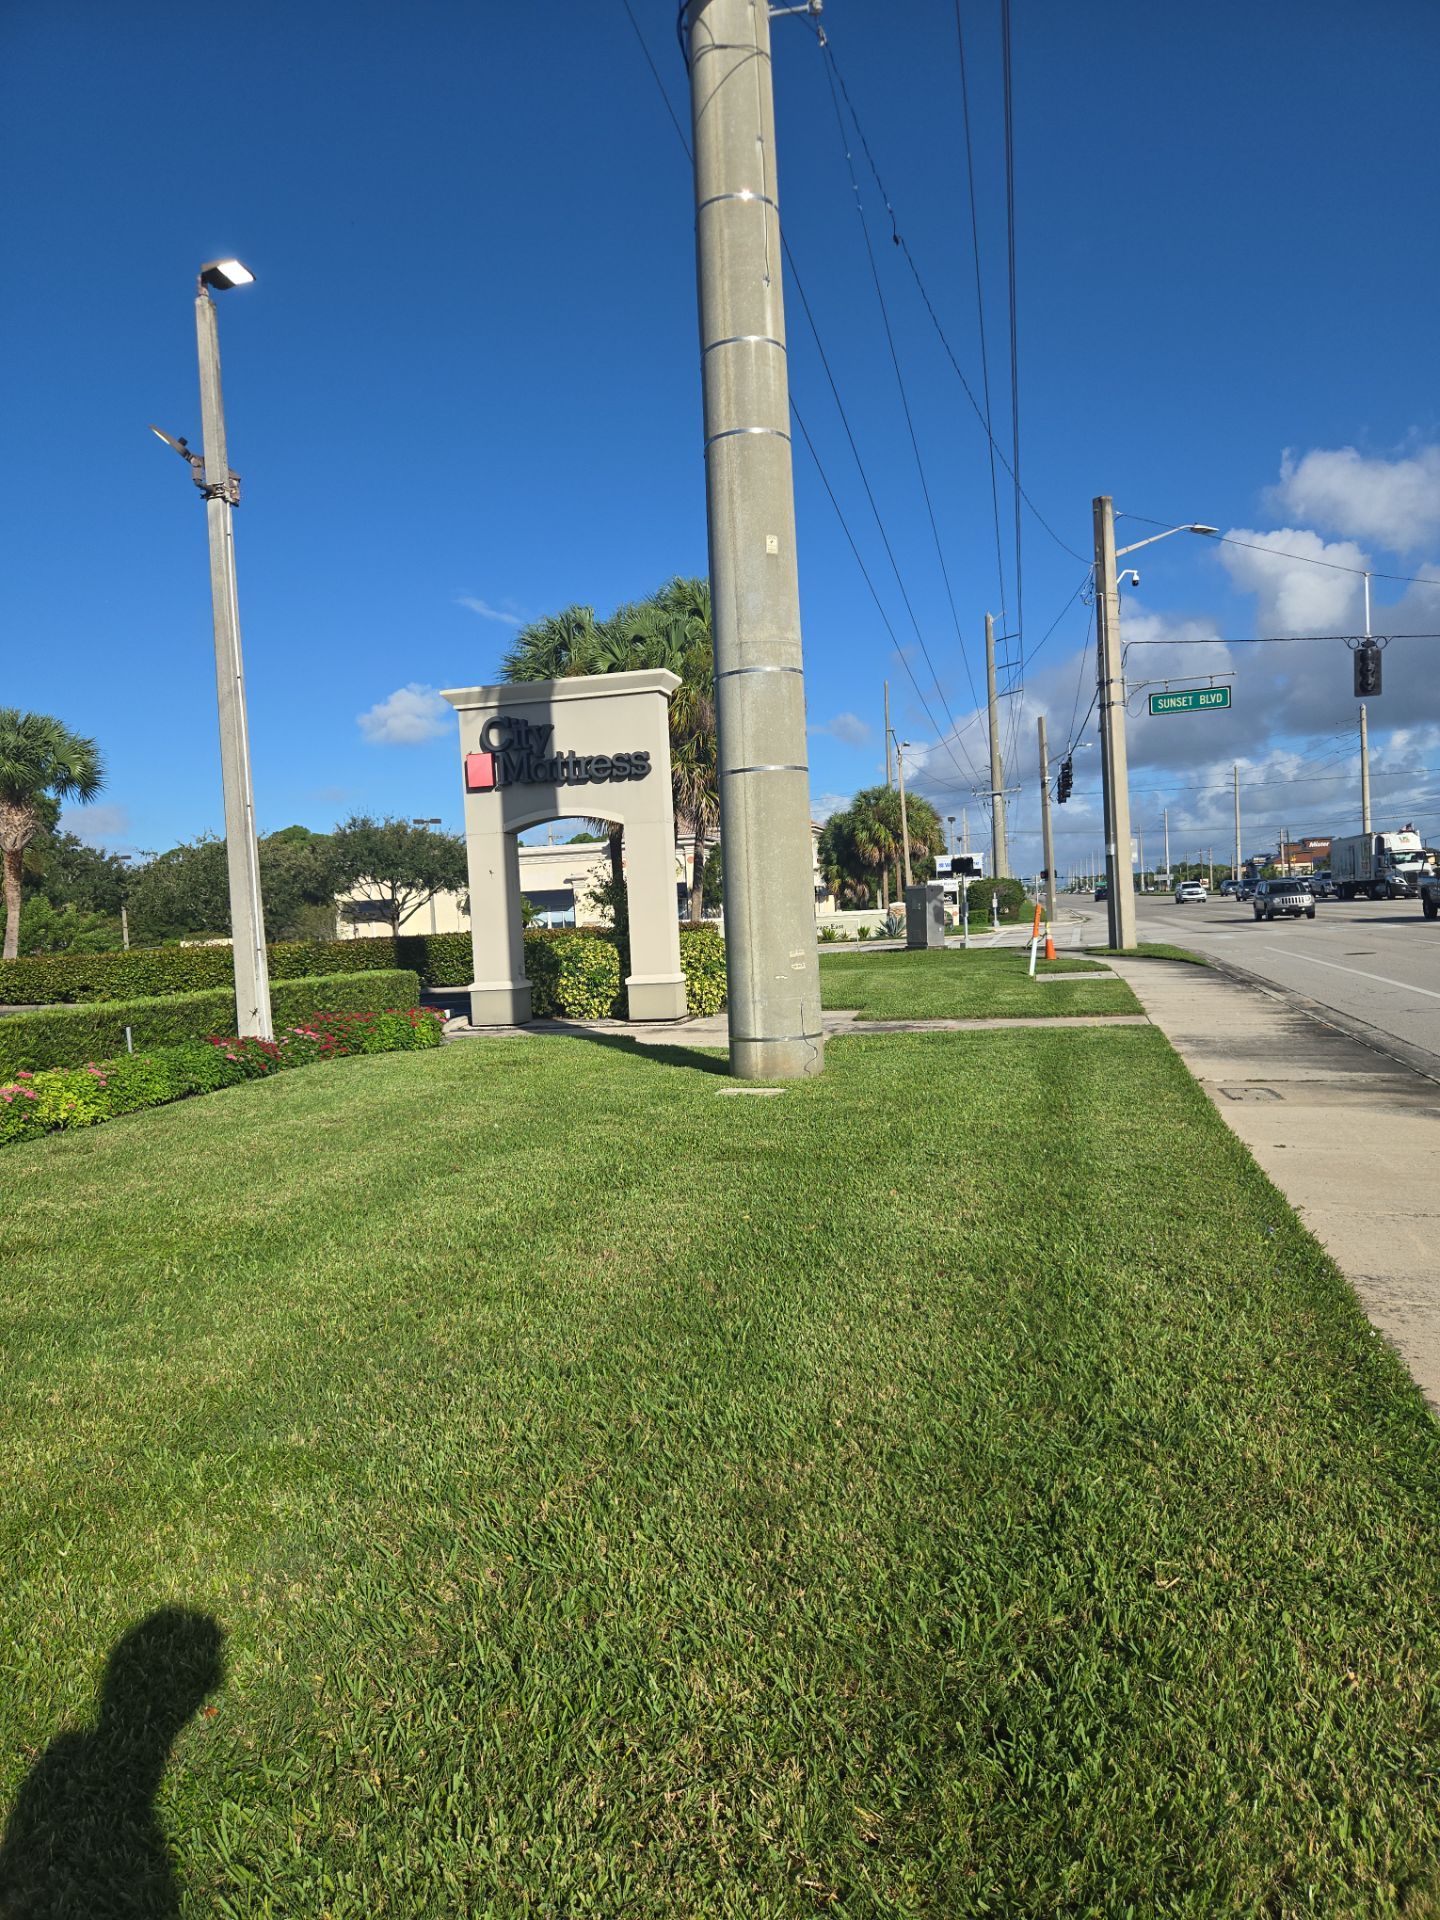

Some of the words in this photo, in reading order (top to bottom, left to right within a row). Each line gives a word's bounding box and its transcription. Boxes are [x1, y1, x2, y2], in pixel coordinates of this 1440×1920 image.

[1158, 696, 1193, 709] SUNSET
[1199, 693, 1223, 705] BLVD
[479, 715, 554, 758] City
[495, 750, 651, 786] Mattress
